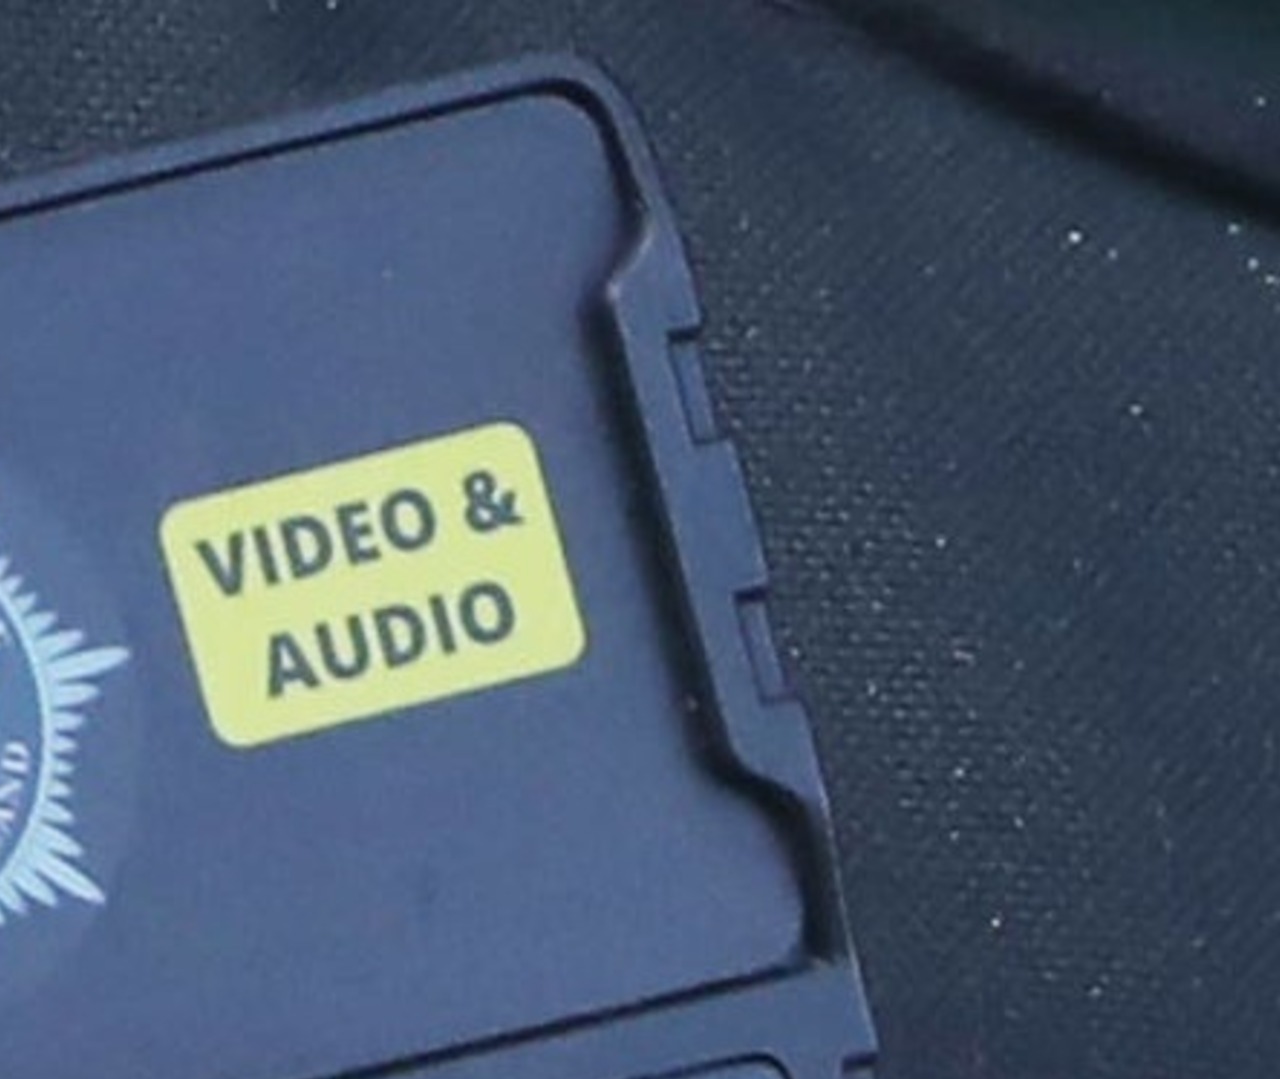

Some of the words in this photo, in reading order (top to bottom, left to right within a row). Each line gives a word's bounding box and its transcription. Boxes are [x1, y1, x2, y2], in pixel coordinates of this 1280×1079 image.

[195, 489, 436, 597] VIDEO
[462, 469, 525, 533] &
[267, 581, 516, 698] AUDIO
